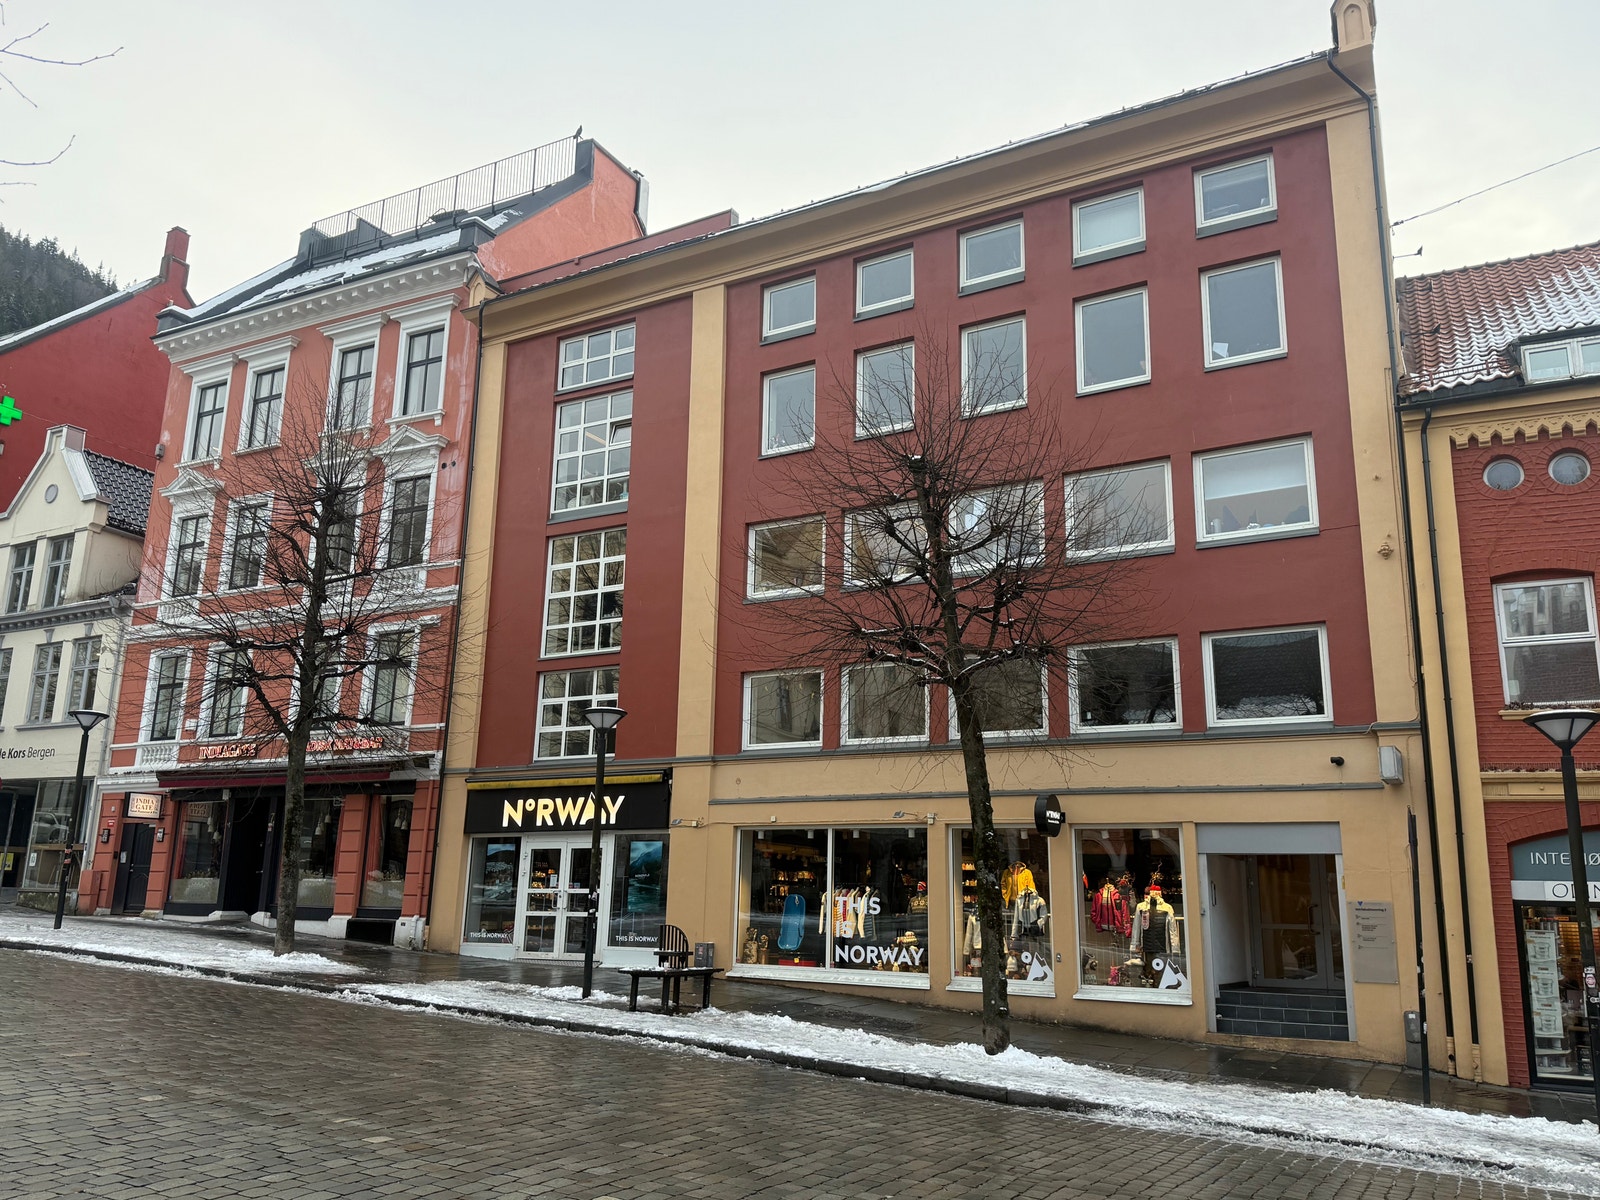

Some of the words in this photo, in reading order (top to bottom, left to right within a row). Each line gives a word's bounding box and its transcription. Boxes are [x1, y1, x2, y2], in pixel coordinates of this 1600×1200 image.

[7, 747, 26, 759] Kors
[27, 746, 56, 761] Bergen
[1530, 851, 1600, 866] INTEIØ
[835, 896, 881, 915] THIS
[835, 921, 853, 939] IS
[835, 944, 925, 966] NORWAY
